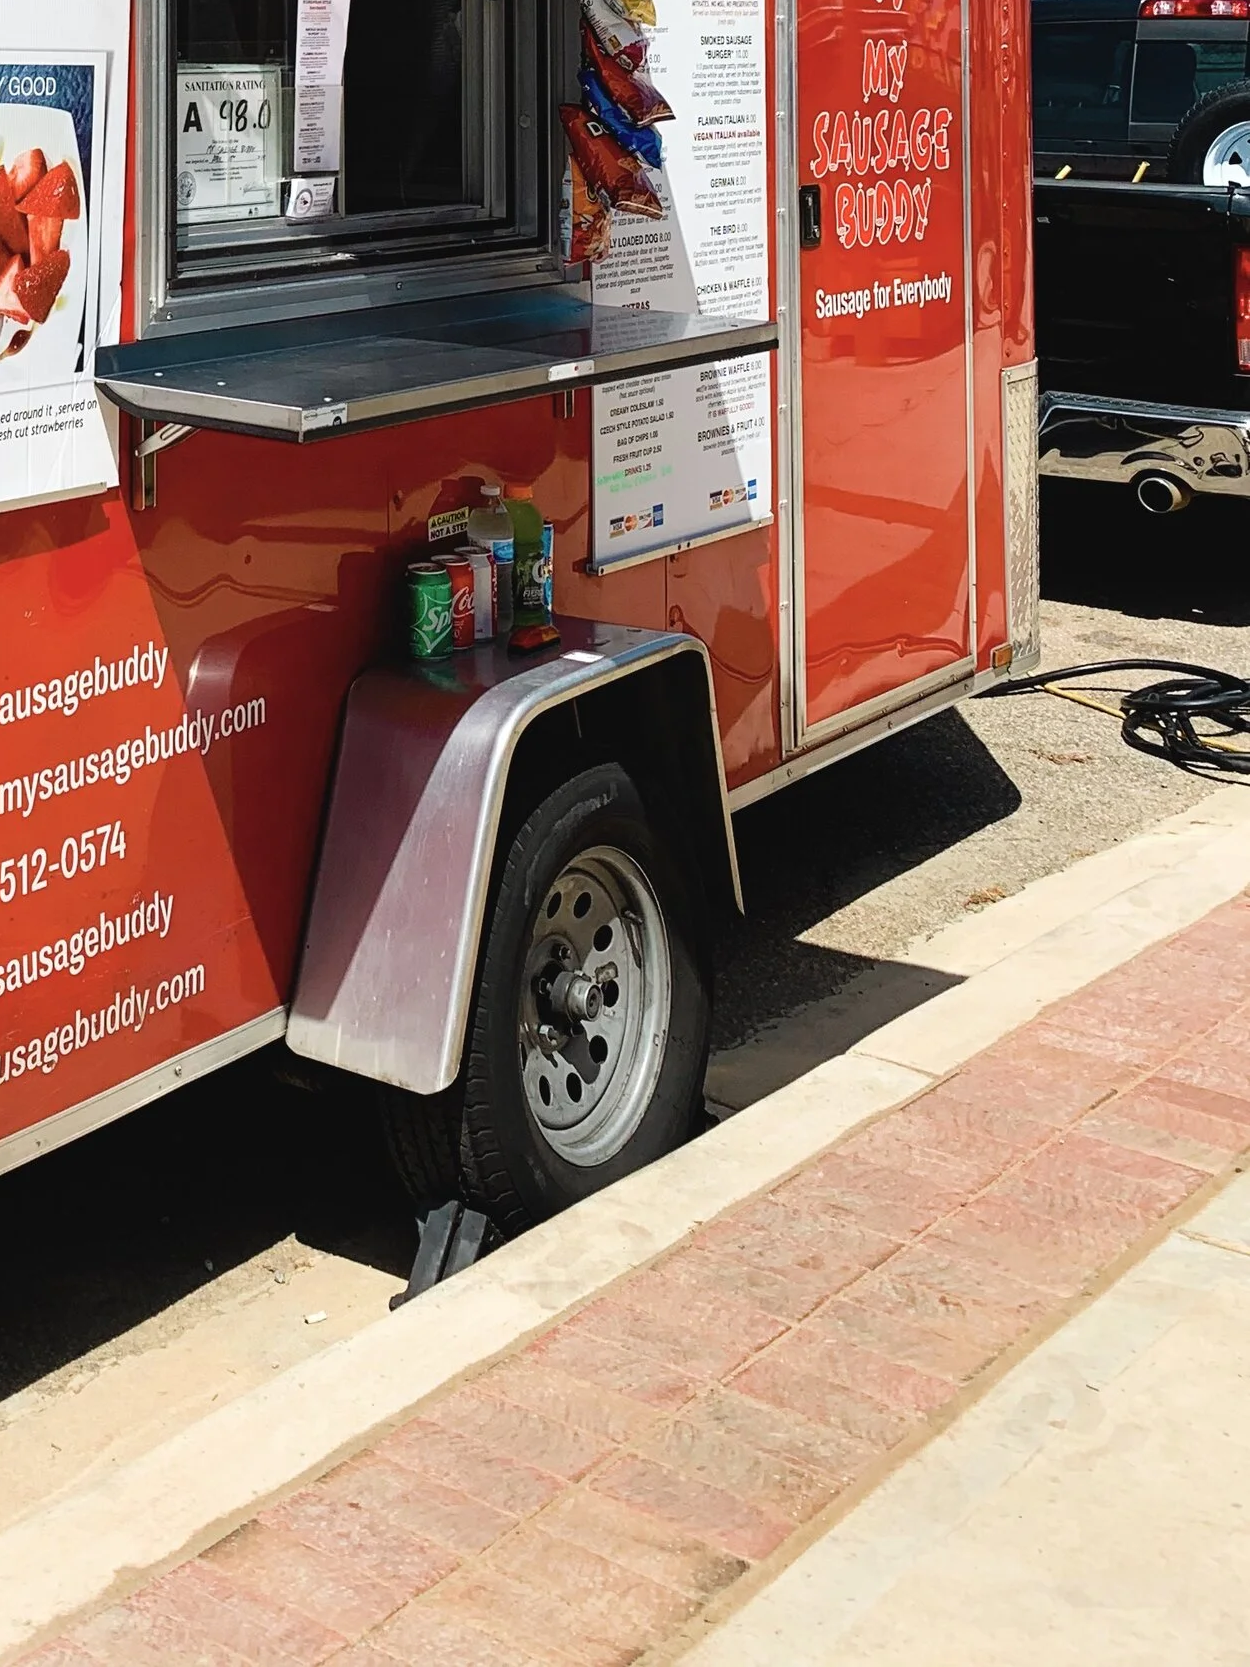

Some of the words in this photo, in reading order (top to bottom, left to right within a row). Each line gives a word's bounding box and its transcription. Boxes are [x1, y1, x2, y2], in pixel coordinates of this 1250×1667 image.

[700, 35, 725, 46] SMOKED
[726, 35, 752, 45] SAUSAGE
[862, 38, 907, 104] MY
[8, 76, 57, 97] GOOD
[184, 81, 234, 92] SANITATION
[236, 80, 265, 91] RATING
[183, 101, 203, 133] A
[219, 99, 272, 133] 98.0
[697, 116, 723, 127] FLAMING
[724, 115, 745, 125] ITALIAN
[693, 131, 714, 142] VEGAN
[714, 130, 737, 140] ITALIAN
[737, 129, 761, 139] available
[810, 107, 953, 179] SAUSAGE
[710, 177, 735, 189] GERMAN
[835, 177, 932, 250] BUDDY
[710, 225, 722, 237] THE
[722, 223, 736, 235] BIRD
[617, 234, 643, 248] LOADED
[644, 233, 659, 245] DOG
[696, 281, 722, 296] CHICKEN
[728, 277, 751, 290] WAFFLE
[816, 288, 871, 319] Sausage
[874, 281, 890, 310] for
[893, 271, 952, 309] Everybody
[700, 368, 728, 383] BROWNIE
[728, 361, 751, 375] WAFFLE
[13, 406, 44, 422] around
[45, 405, 53, 418] it
[87, 399, 97, 412] on
[610, 404, 630, 417] CREAMY
[630, 399, 655, 413] COLESLAW
[655, 397, 664, 407] 1.50
[14, 425, 29, 439] cut
[31, 417, 84, 436] strawberries
[600, 424, 616, 435] CZECH
[616, 420, 631, 432] STYLE
[631, 416, 650, 429] POTATO
[650, 413, 666, 424] SALAD
[666, 411, 675, 420] 1.50
[697, 424, 730, 443] BROWNIES
[736, 418, 754, 432] FRUIT
[617, 436, 628, 447] BAG
[628, 434, 635, 444] OF
[635, 431, 649, 443] CHIPS
[650, 430, 658, 439] 1.00
[613, 451, 629, 464] FRESH
[629, 449, 643, 461] FRUIT
[643, 446, 653, 457] CUP
[653, 444, 662, 454] 2.50
[624, 465, 642, 477] DRINKS
[643, 462, 652, 472] 1.25
[437, 510, 466, 526] CAUTION
[430, 527, 444, 541] NOT
[446, 524, 451, 536] A
[0, 821, 127, 903] 512-0574
